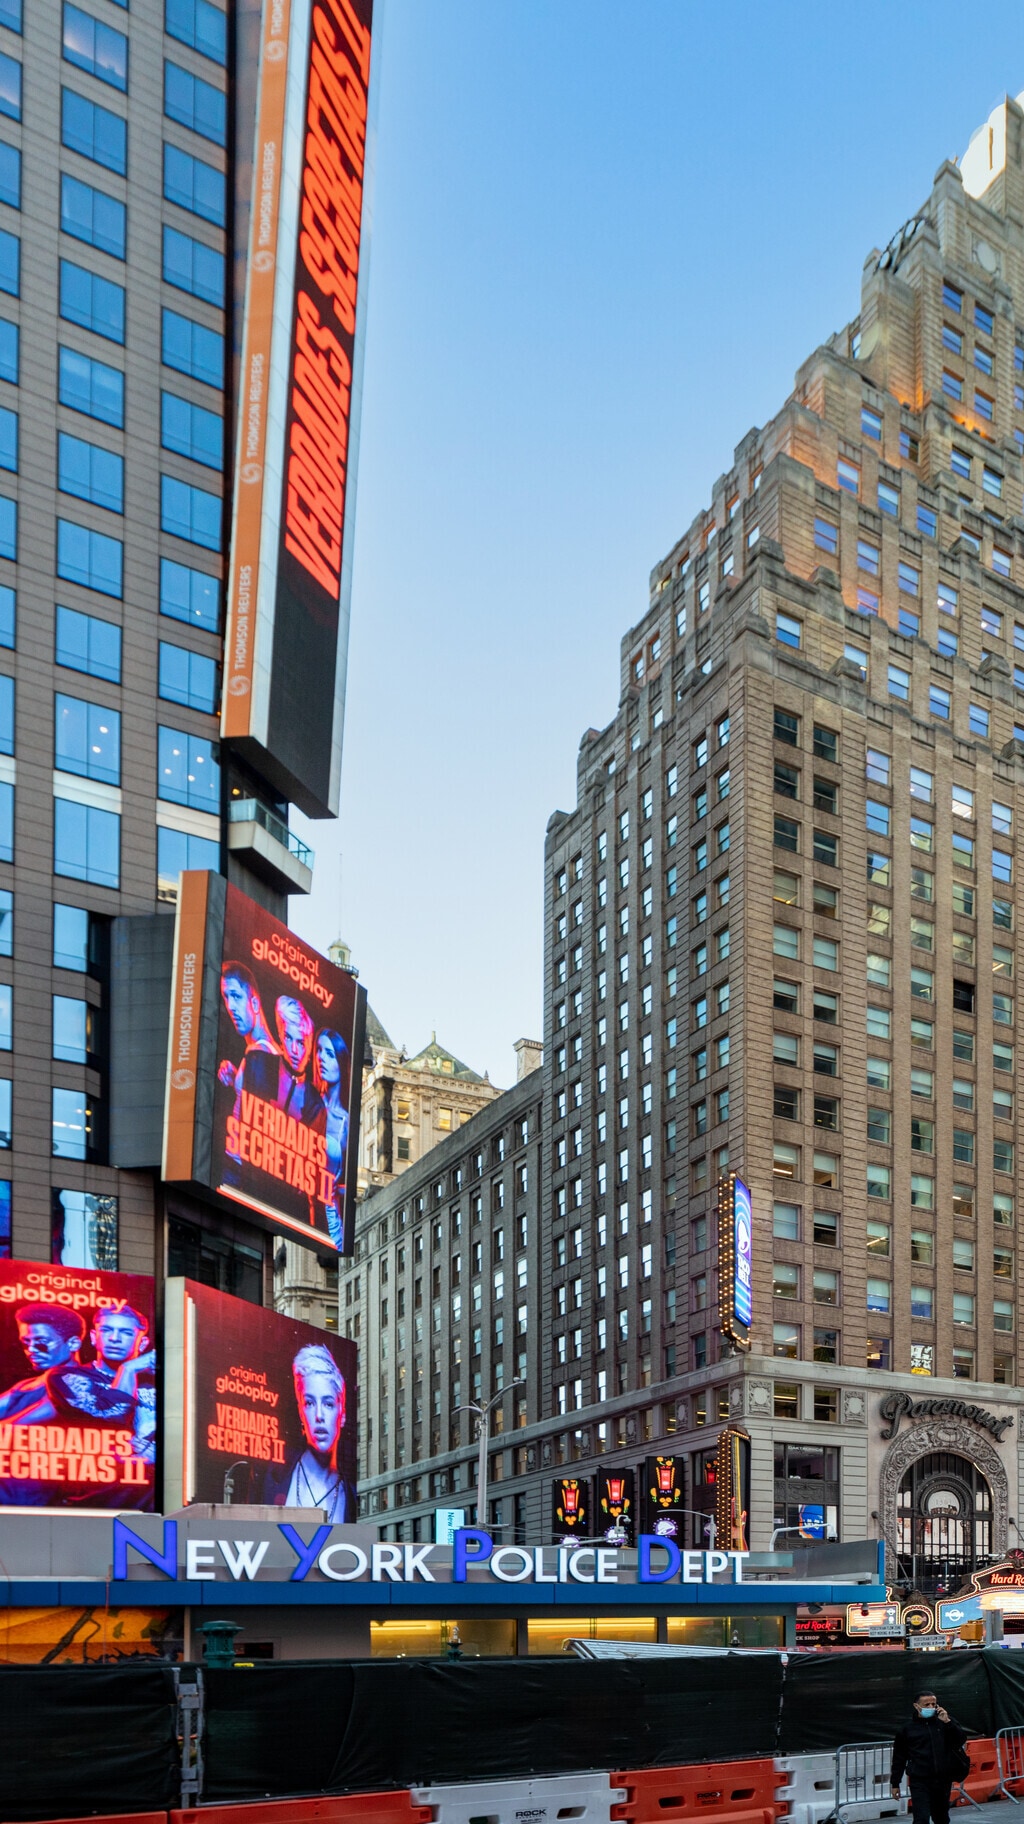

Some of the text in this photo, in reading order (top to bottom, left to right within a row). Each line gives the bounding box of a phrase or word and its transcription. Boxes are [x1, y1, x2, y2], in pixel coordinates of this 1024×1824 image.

[258, 141, 277, 246] THOMSON REUTERS
[300, 5, 367, 335] SECRETAS
[247, 353, 265, 457] THOMSON REUTERS
[286, 290, 351, 600] VERDADES
[235, 565, 252, 670] THOMSON REUTERS
[252, 938, 334, 1008] globoplay
[271, 933, 319, 977] original
[178, 953, 197, 1063] THOMSON REUTERS
[240, 1089, 328, 1167] VERDADES
[225, 1115, 336, 1206] SECRETAS II
[0, 1284, 128, 1312] globoplay
[26, 1272, 102, 1292] original
[216, 1377, 278, 1407] globoplay
[229, 1365, 267, 1386] original
[216, 1403, 278, 1439] VERDADES
[880, 1392, 1014, 1443] Paramount
[208, 1424, 286, 1464] SECRETAS II
[0, 1451, 149, 1485] ECRETAS II
[113, 1518, 750, 1584] NEW YORK POLICE DEPT
[990, 1573, 1013, 1584] Hard
[796, 1620, 831, 1631] ard Rock
[516, 1809, 546, 1817] ROCK
